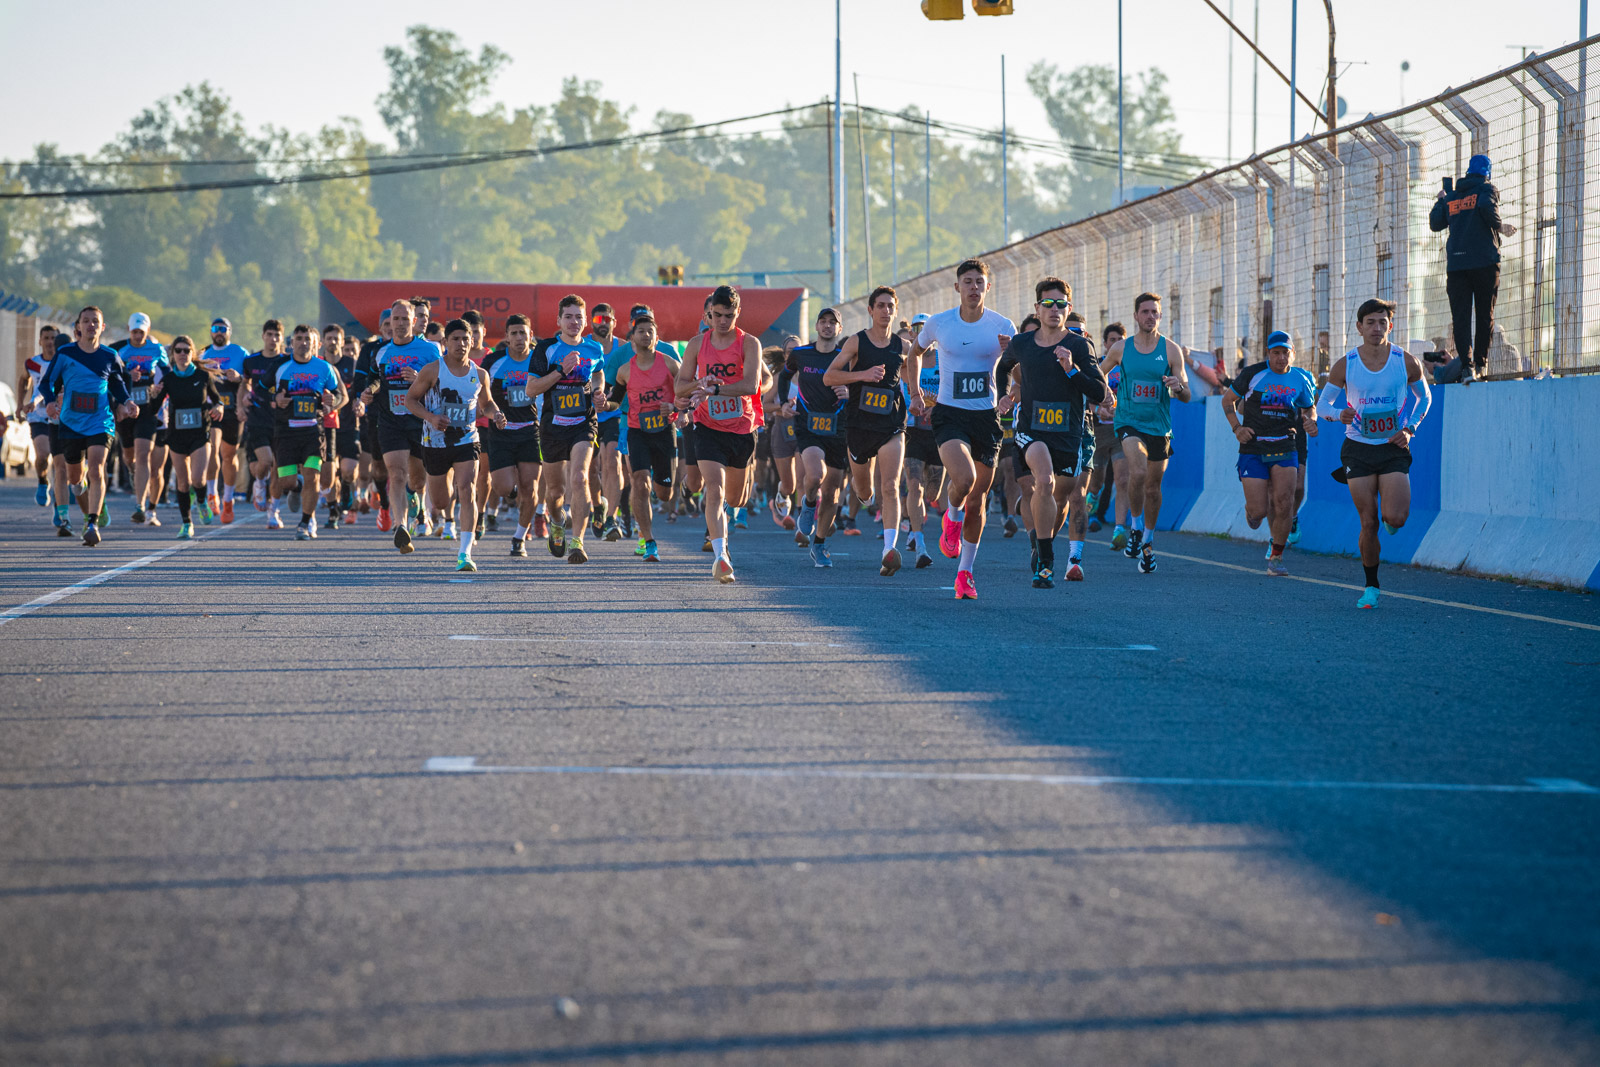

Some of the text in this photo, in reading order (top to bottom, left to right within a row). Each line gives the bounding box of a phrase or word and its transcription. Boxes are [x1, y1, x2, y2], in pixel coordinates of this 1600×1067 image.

[962, 378, 985, 393] 106
[1135, 384, 1156, 398] 344
[297, 401, 315, 413] 756
[558, 393, 580, 409] 707
[713, 398, 737, 415] 313
[865, 392, 888, 408] 718
[182, 412, 194, 425] 21
[447, 406, 467, 421] 174
[1038, 408, 1064, 425] 706
[644, 415, 665, 430] 712
[812, 416, 832, 431] 782
[1368, 416, 1394, 433] 303
